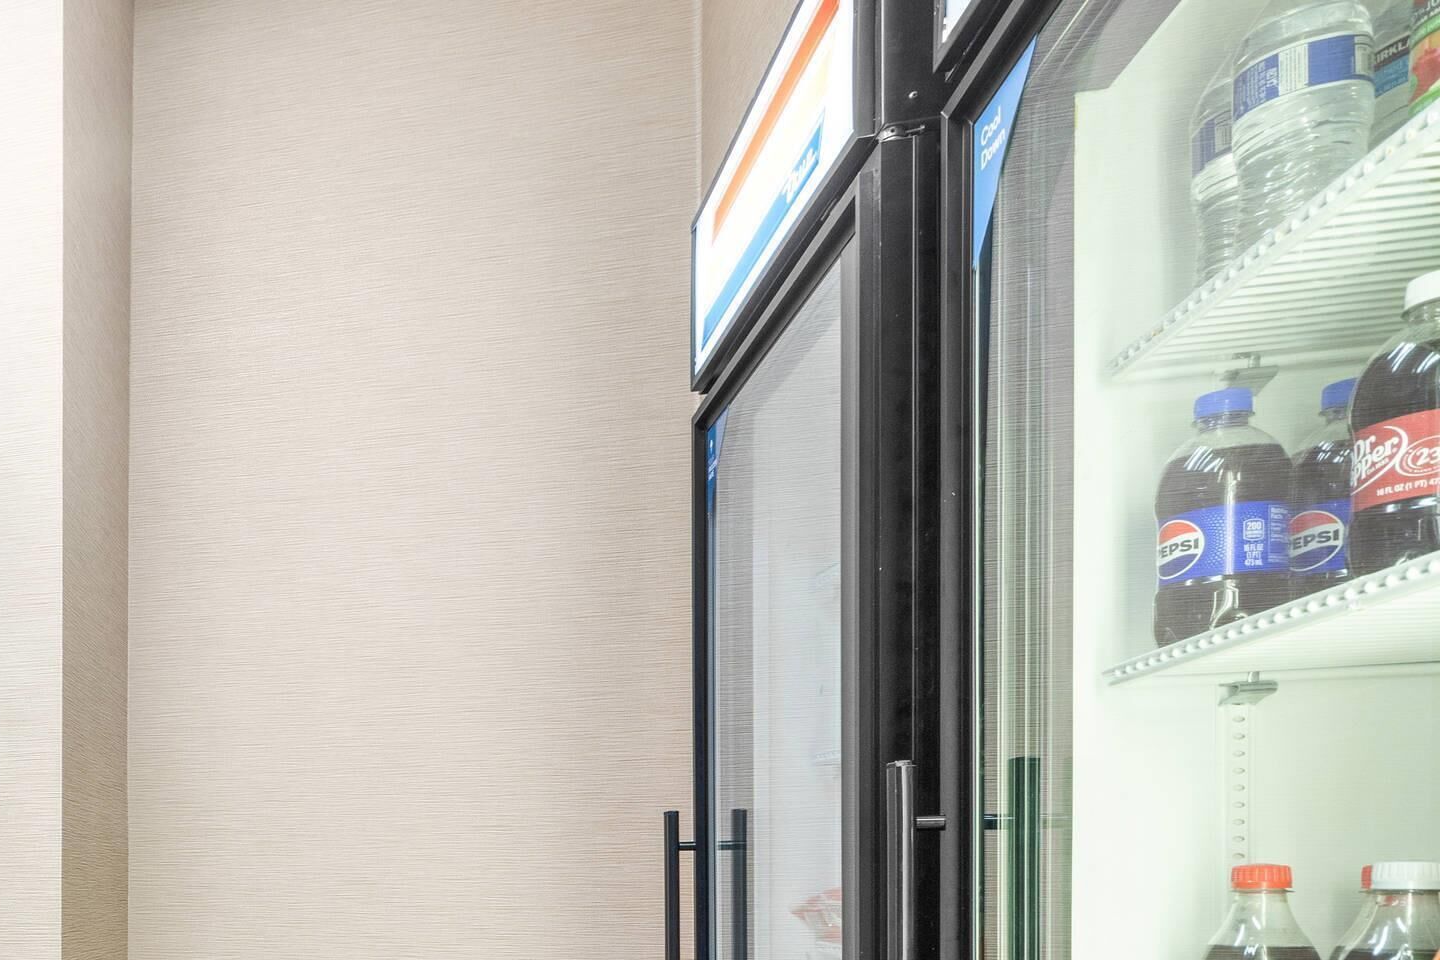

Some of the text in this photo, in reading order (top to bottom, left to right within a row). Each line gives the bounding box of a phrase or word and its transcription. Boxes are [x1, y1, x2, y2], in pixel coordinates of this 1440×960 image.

[981, 106, 1001, 146] Cool
[980, 129, 1006, 170] Down
[1385, 486, 1393, 494] FL
[1394, 484, 1404, 492] OZ
[1414, 479, 1428, 488] PT)
[1246, 521, 1261, 530] 200
